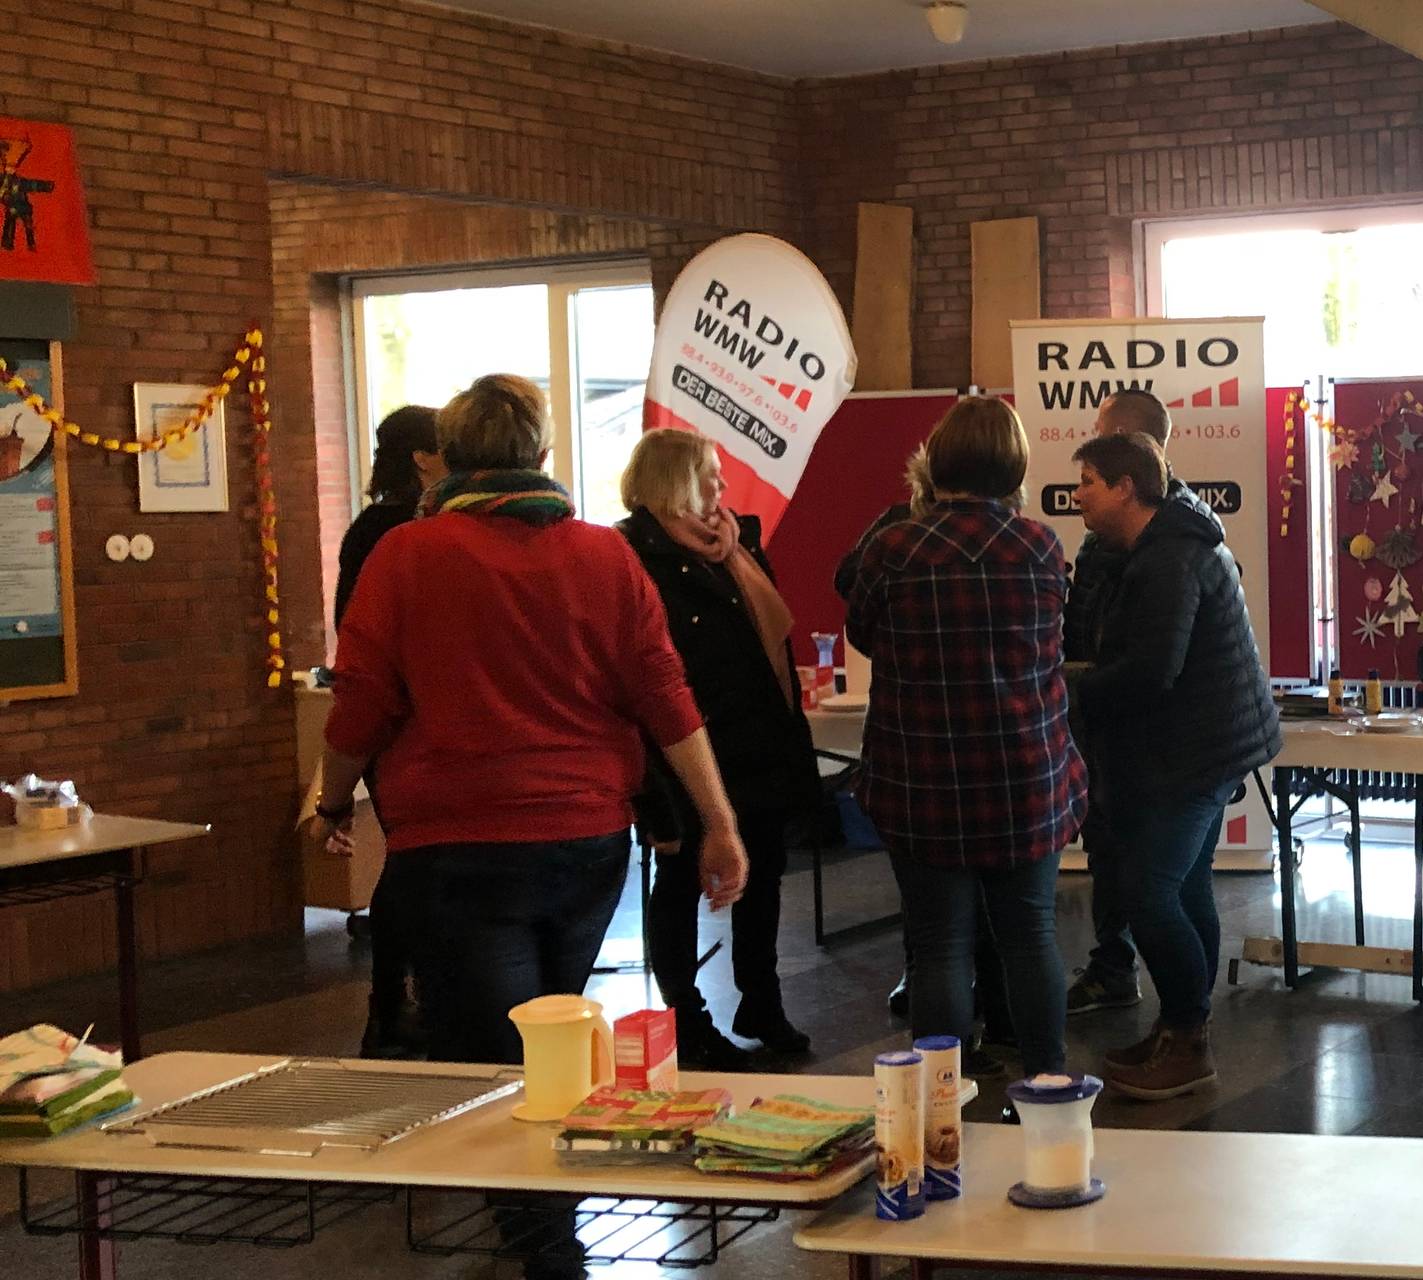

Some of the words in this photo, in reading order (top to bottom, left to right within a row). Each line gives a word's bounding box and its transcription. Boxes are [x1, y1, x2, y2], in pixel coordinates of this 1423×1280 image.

[693, 307, 766, 371] WMW
[703, 279, 826, 382] RADIO
[1038, 337, 1239, 371] RADIO
[677, 370, 707, 401] DER
[705, 390, 750, 430] BESTE
